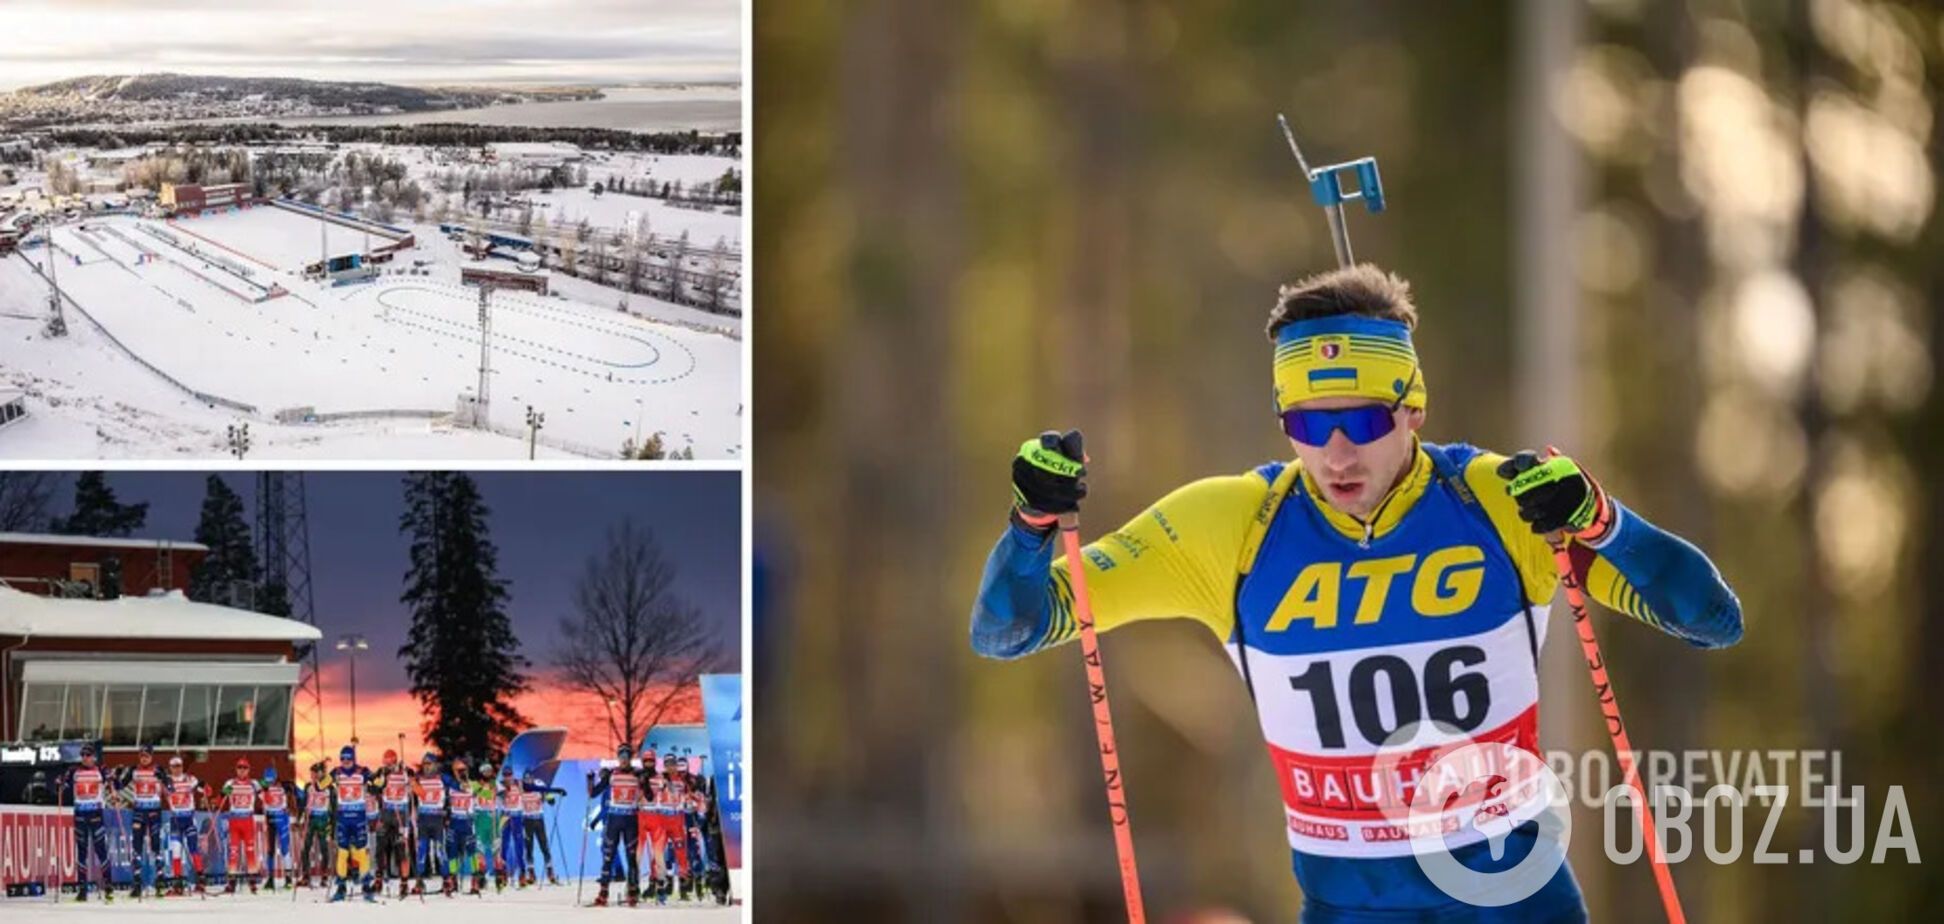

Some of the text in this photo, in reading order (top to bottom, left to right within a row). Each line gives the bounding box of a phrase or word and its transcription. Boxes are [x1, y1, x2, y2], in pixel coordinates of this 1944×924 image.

[1265, 545, 1486, 633] ATG
[1289, 645, 1492, 750] 106
[1293, 735, 1522, 804] BAUHAUS
